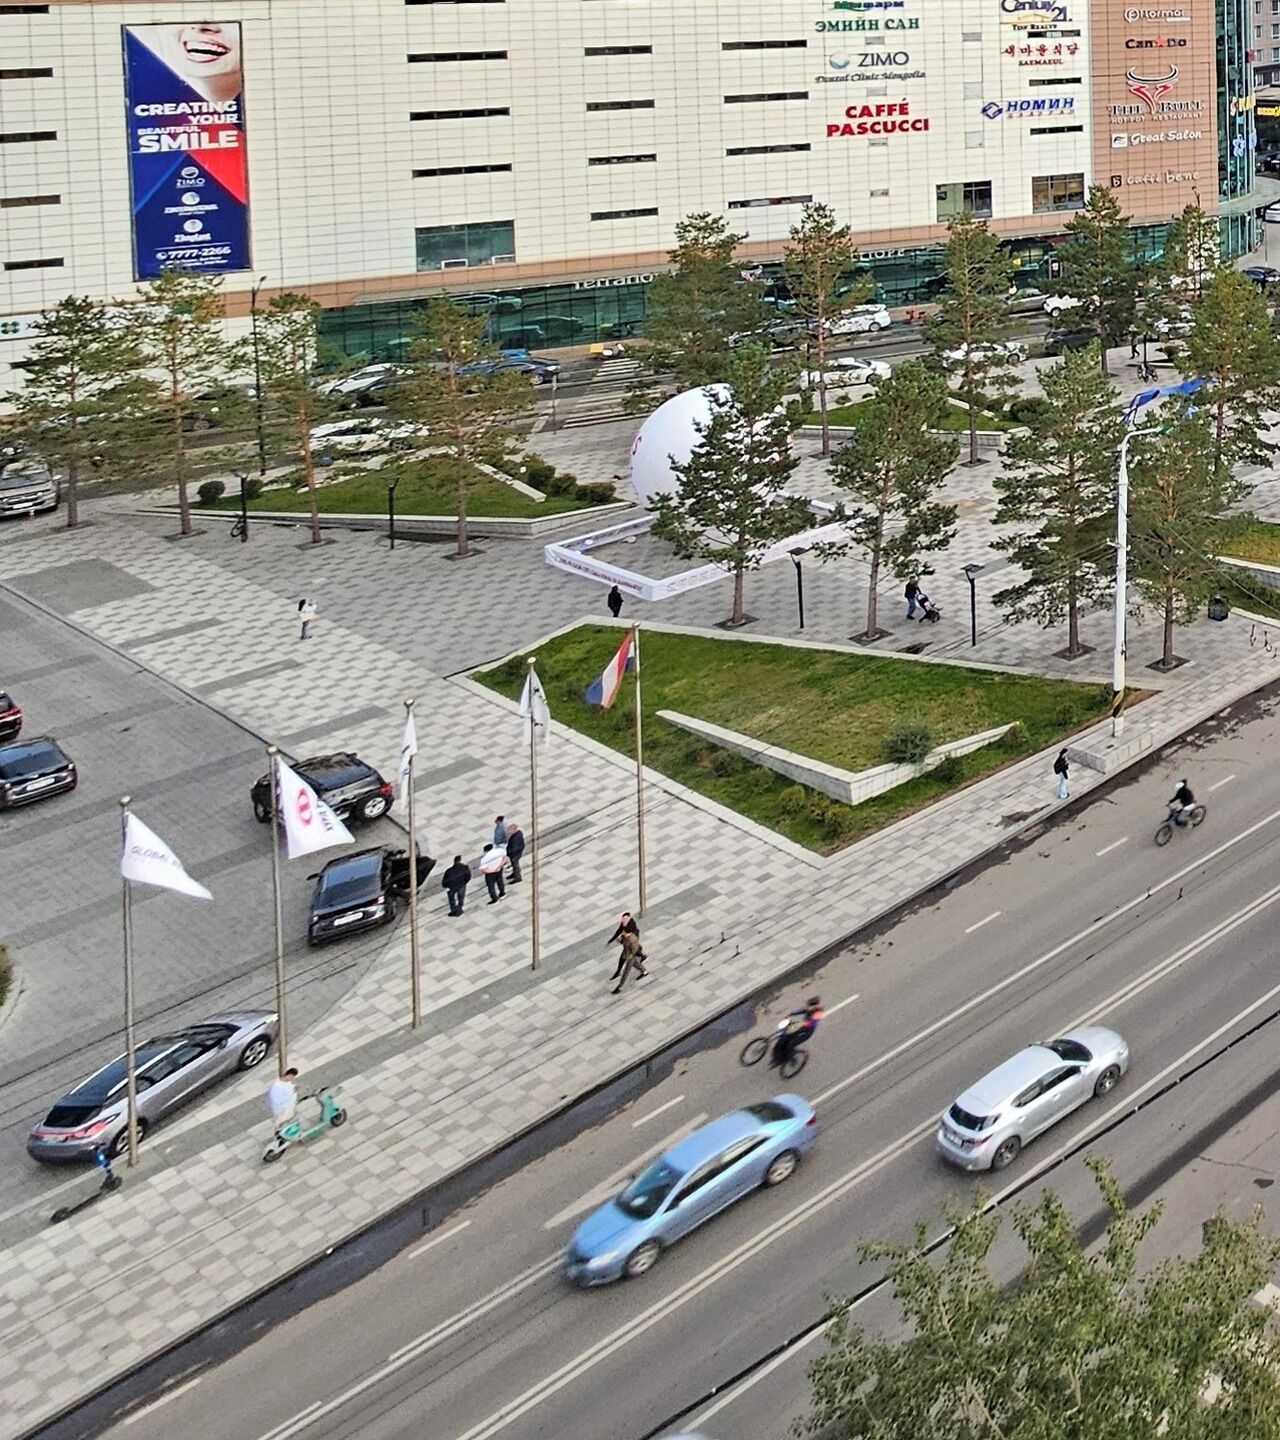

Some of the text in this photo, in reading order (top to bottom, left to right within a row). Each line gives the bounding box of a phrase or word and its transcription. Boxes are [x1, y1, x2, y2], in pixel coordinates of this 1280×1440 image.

[815, 16, 920, 33] ЭМИЙН САН
[858, 51, 910, 67] ZIMO
[134, 101, 238, 116] CREATING
[845, 97, 910, 119] CAFFÉ
[1006, 97, 1075, 112] НОМИН
[187, 113, 239, 125] YOUR
[137, 125, 201, 136] BEAUTIFUL
[826, 118, 930, 138] PASCUCCI
[138, 130, 240, 153] SMILE
[1130, 129, 1203, 146] Great Salon
